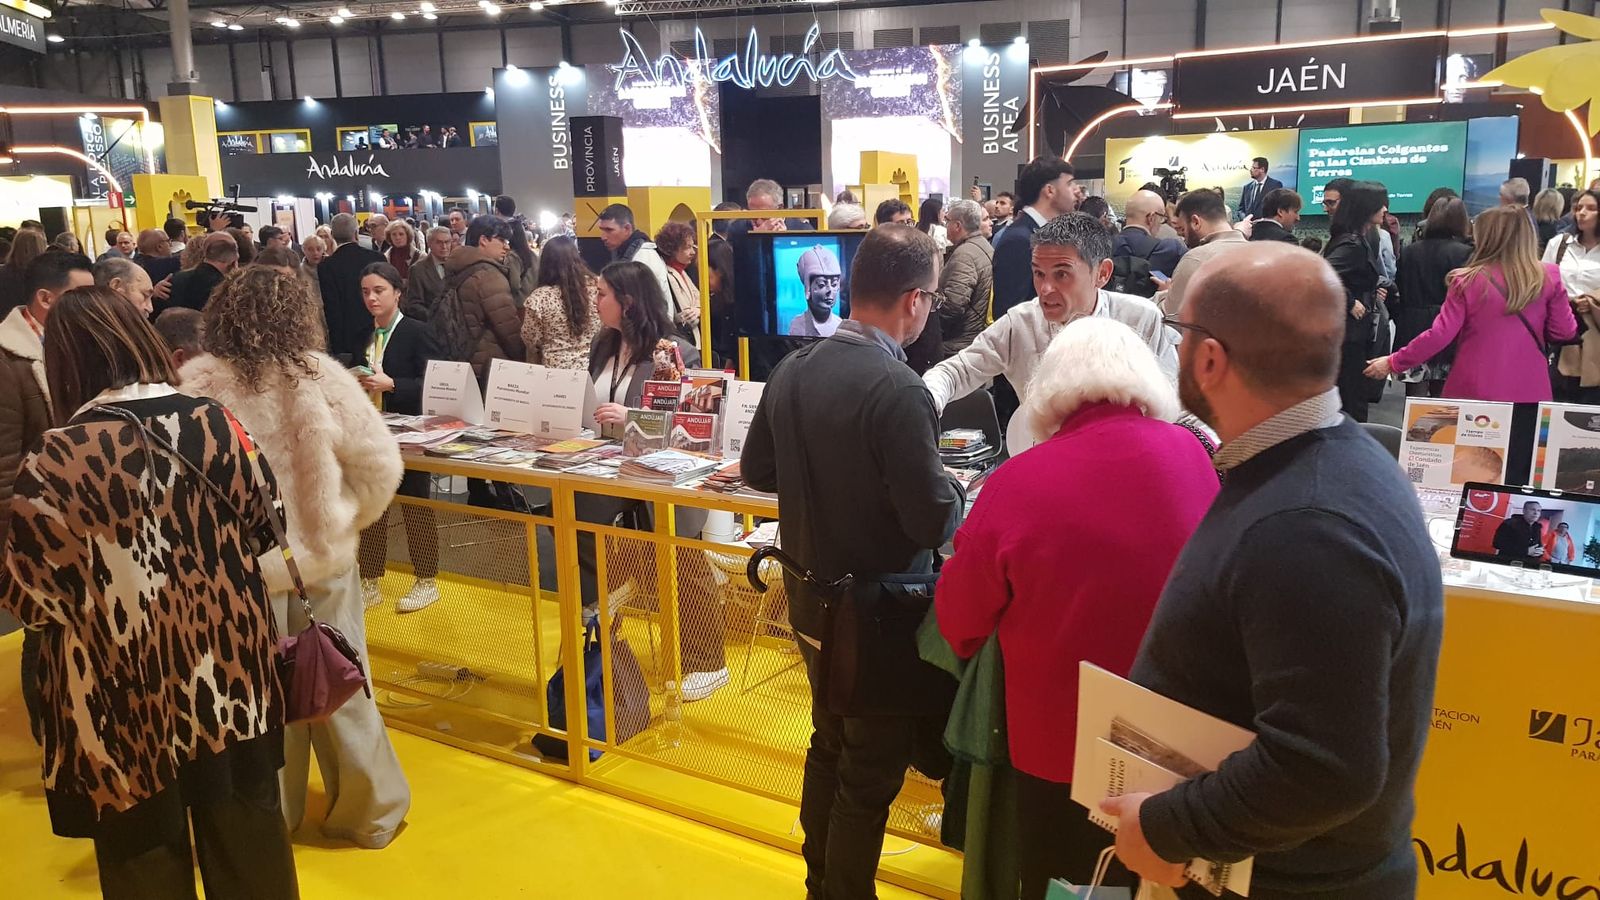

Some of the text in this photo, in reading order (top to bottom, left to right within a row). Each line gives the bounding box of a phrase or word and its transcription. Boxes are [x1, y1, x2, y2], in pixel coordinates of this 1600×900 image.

[0, 15, 37, 42] LMERÍA
[606, 21, 858, 91] Andalucía
[1257, 57, 1346, 94] JAÉN
[983, 52, 1000, 154] BUSINESS
[549, 75, 568, 169] BUSINESS
[306, 154, 391, 179] Andalucía
[584, 126, 595, 192] PROVINCIA
[1309, 168, 1352, 177] Torres
[1410, 154, 1427, 164] de
[1432, 707, 1480, 724] TACION
